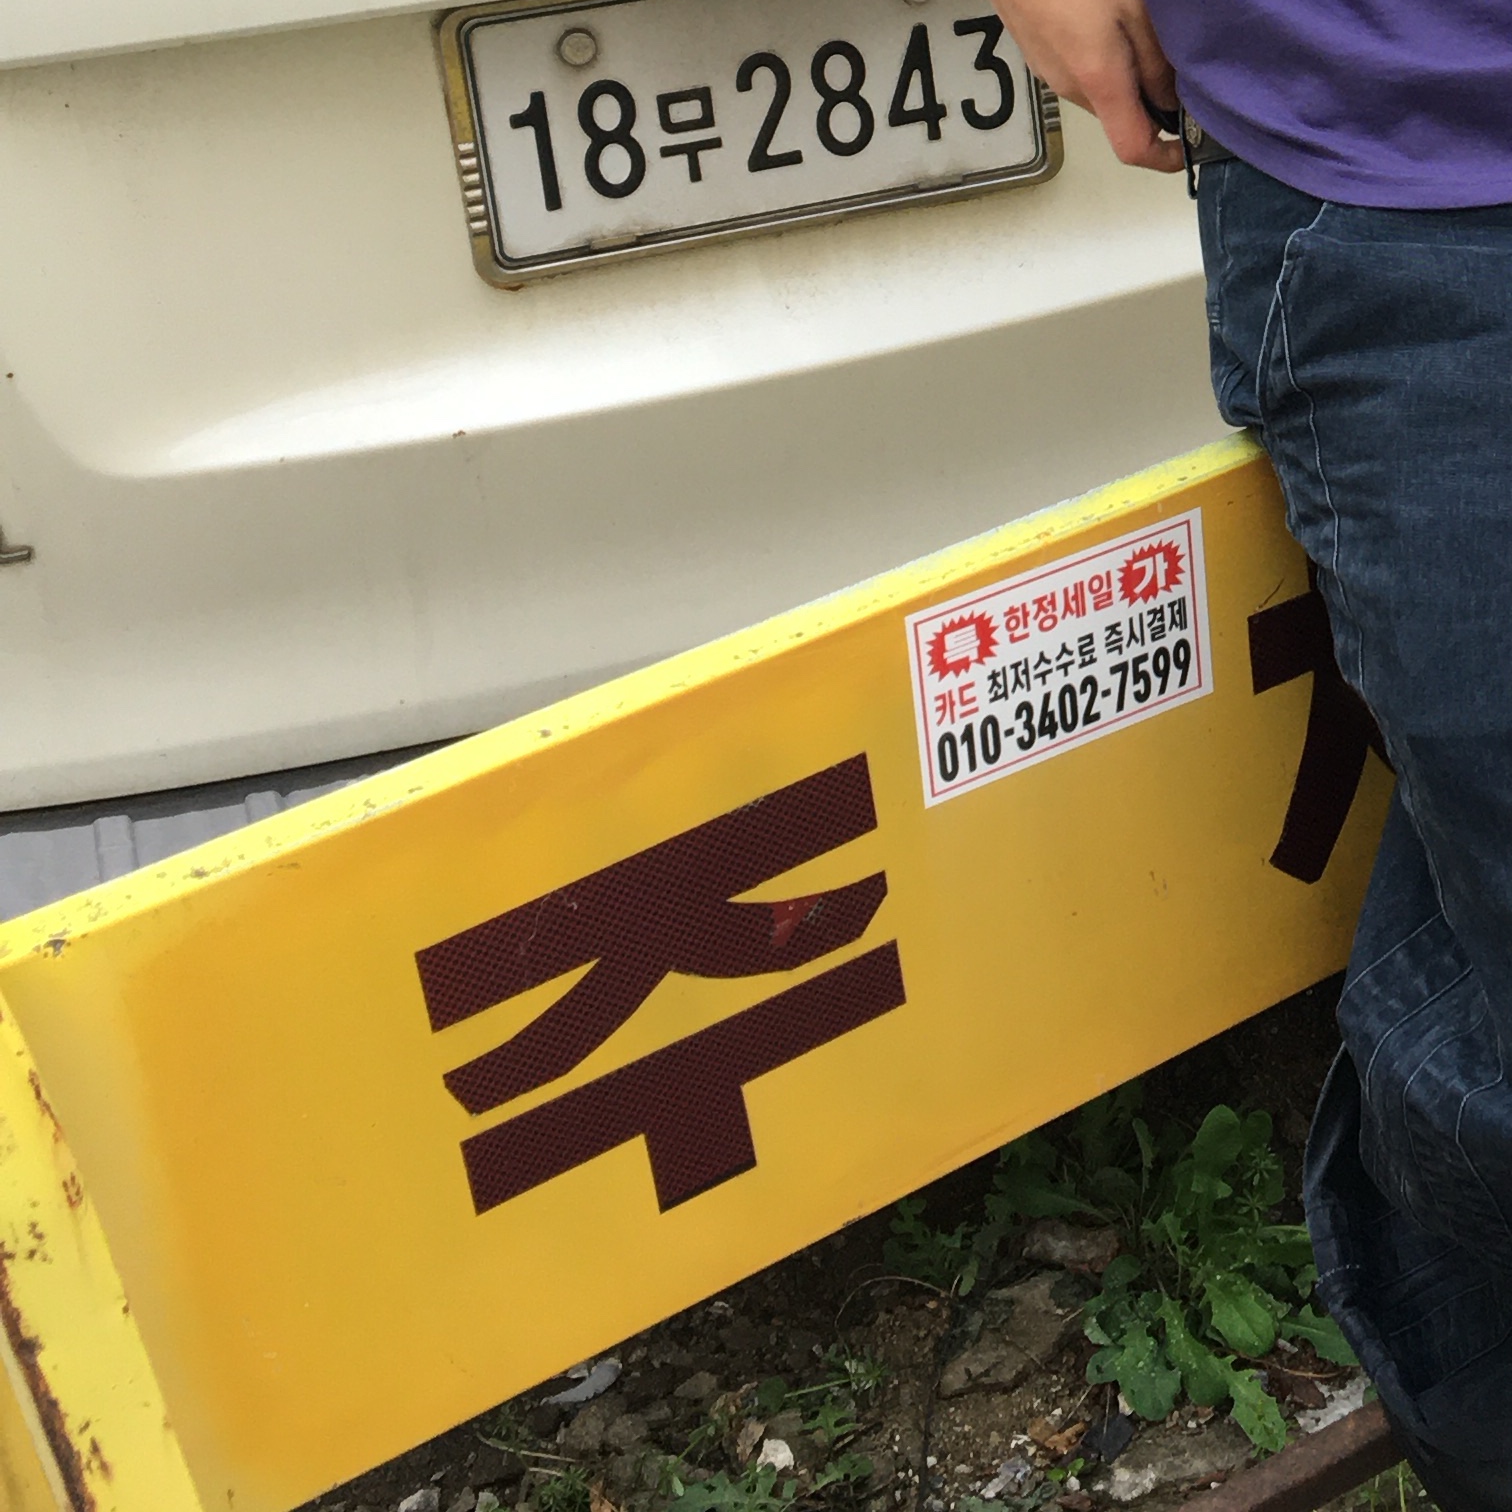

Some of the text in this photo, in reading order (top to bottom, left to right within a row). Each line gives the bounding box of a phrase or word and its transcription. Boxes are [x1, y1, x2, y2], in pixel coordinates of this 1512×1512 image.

[508, 14, 1016, 212] 18무2843
[934, 595, 1188, 727] 카드 최저수수료 즉시결제
[1003, 570, 1114, 645] 한정세일
[1132, 551, 1169, 595] 가
[937, 638, 1192, 782] 010-3402-7599
